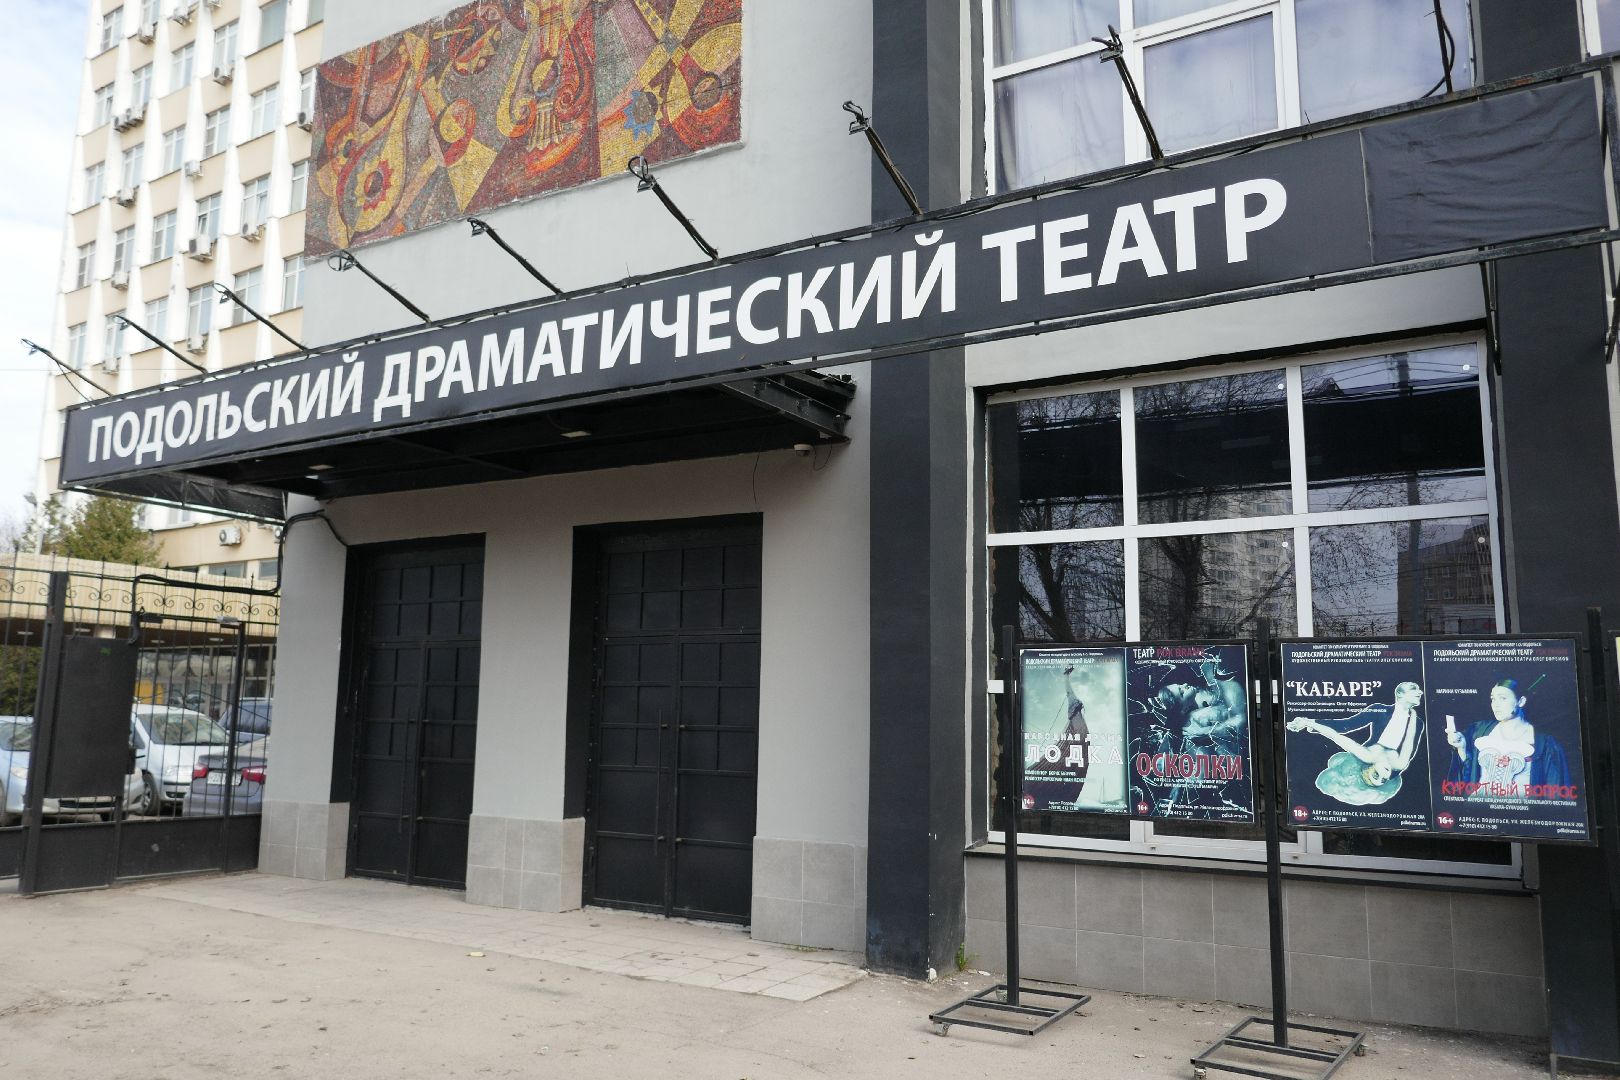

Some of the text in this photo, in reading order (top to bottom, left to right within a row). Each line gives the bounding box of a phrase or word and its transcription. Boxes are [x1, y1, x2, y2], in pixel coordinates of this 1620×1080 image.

[88, 178, 1288, 465] ПОДОЛЬСКИЙ ДРАМАТИЧЕСКИЙ ТЕАТР
[1132, 648, 1155, 659] ТЕАТР
[1286, 680, 1382, 697] “КАБАРЕ”
[1024, 744, 1124, 768] ЛОДКА
[1136, 752, 1243, 780] ОСКОЛКИ
[1441, 779, 1578, 799] КУРОРТНЫЙ ВОПРОС
[1293, 809, 1308, 817] 18+
[1437, 816, 1454, 824] 16+
